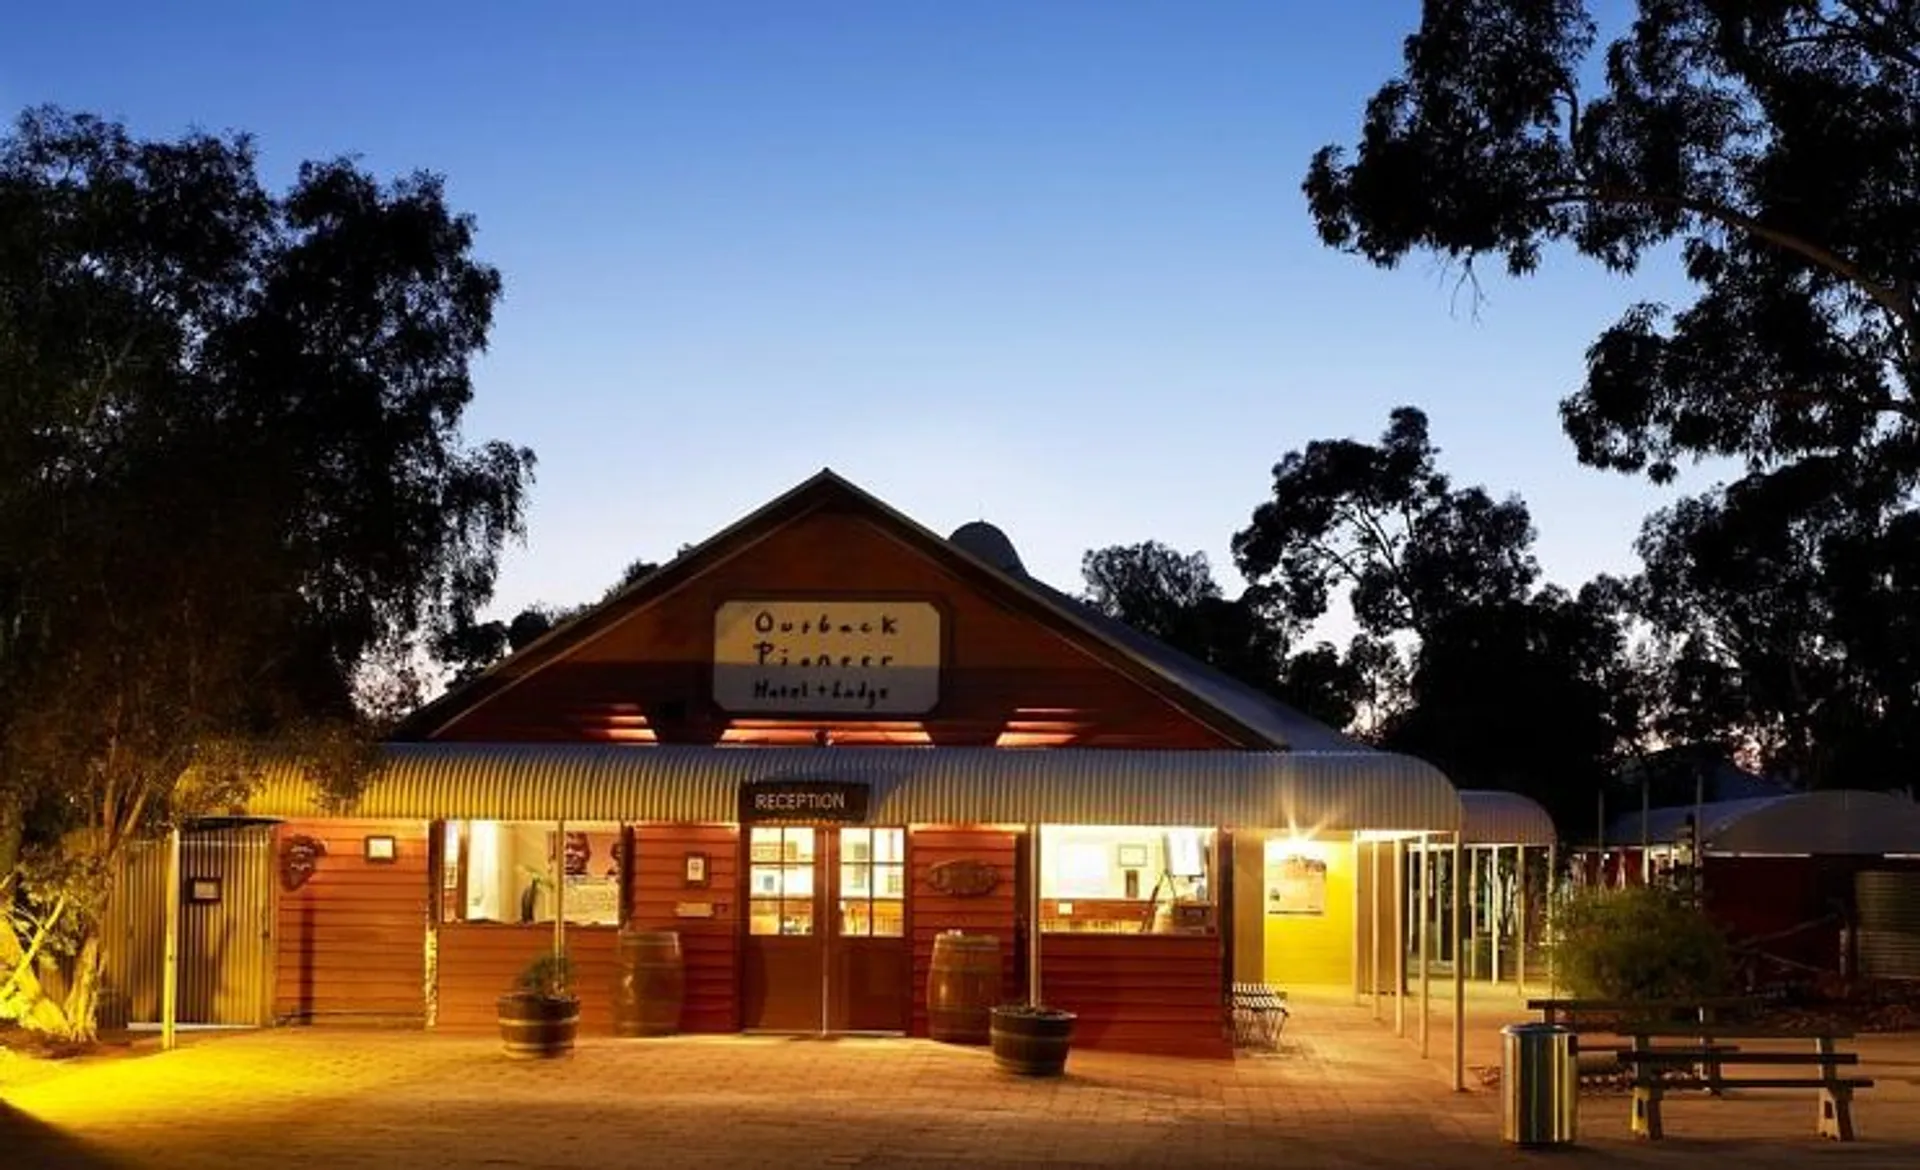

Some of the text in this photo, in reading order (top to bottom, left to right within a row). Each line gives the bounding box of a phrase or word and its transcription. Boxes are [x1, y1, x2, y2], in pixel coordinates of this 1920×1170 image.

[755, 612, 897, 633] Outback
[753, 641, 893, 667] Pioneer
[754, 681, 807, 699] Hotel
[832, 681, 889, 708] Lodge
[755, 793, 845, 809] RECEPTION
